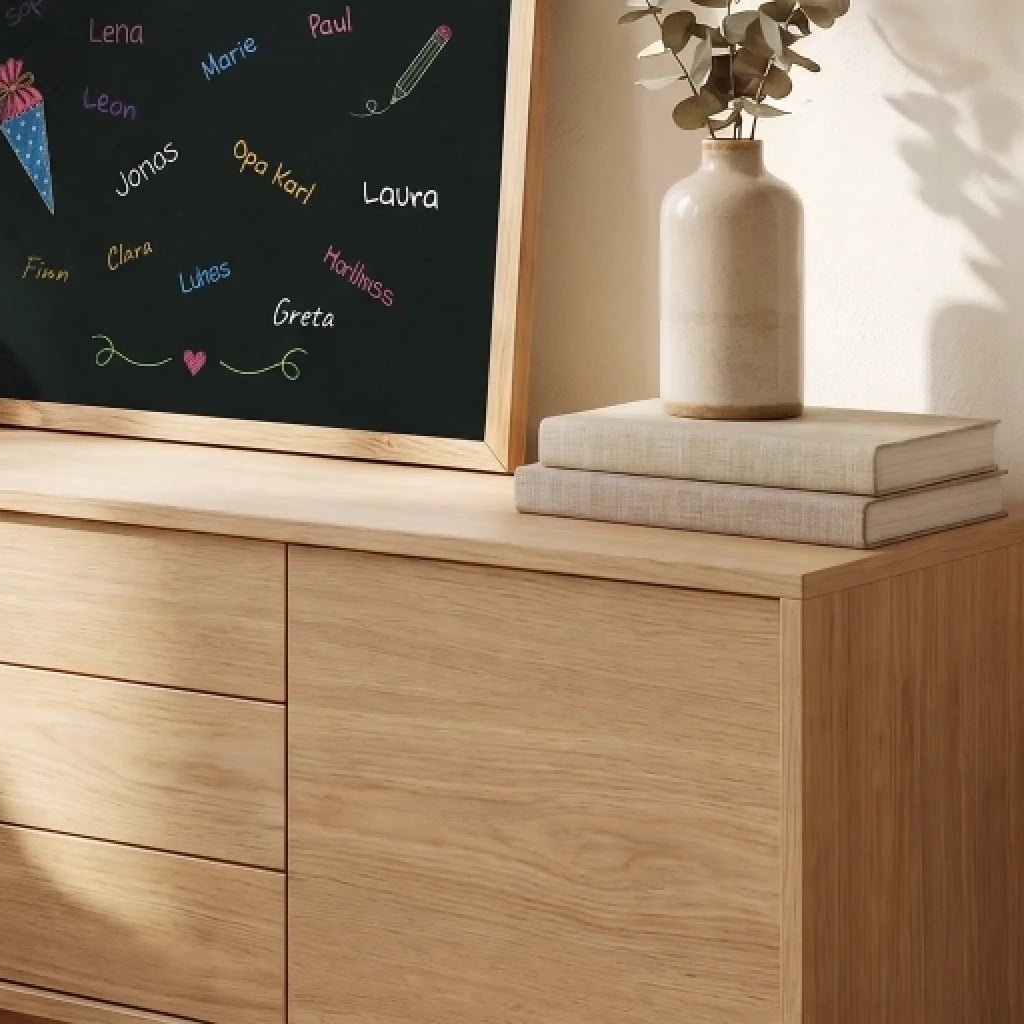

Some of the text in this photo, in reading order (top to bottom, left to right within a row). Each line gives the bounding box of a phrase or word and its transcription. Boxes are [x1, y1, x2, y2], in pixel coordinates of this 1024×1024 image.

[89, 17, 144, 45] Lena
[308, 5, 353, 39] Paul
[200, 37, 258, 81] Marie
[83, 86, 138, 120] Leon
[115, 141, 179, 197] Jonas
[233, 139, 317, 205] Opa Karl
[363, 181, 439, 211] Laura
[107, 241, 153, 271] Clara
[273, 297, 335, 329] Greta
